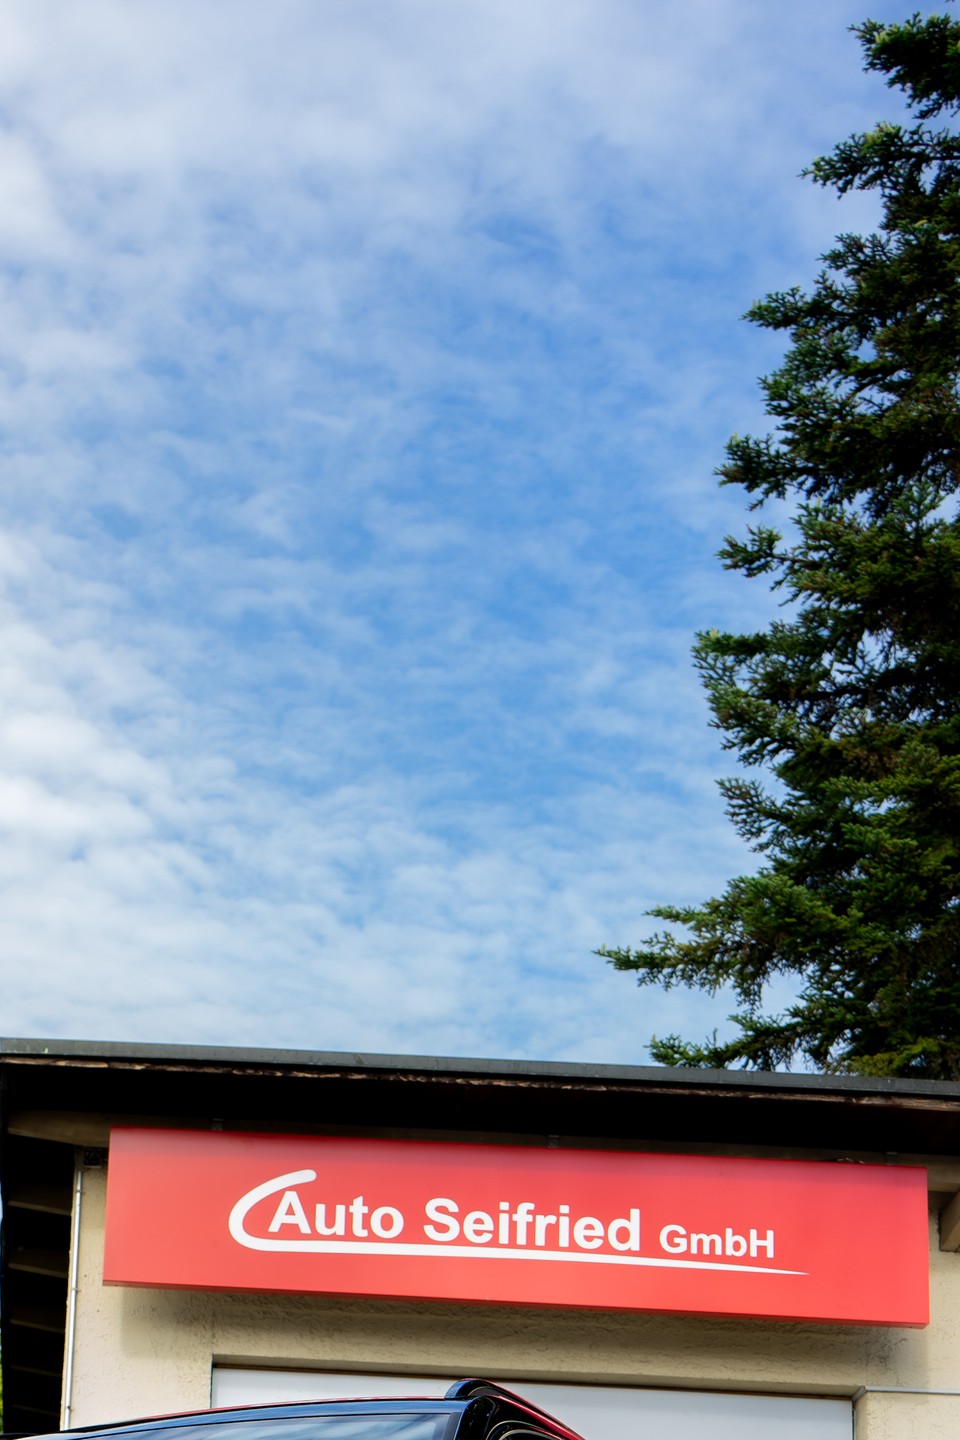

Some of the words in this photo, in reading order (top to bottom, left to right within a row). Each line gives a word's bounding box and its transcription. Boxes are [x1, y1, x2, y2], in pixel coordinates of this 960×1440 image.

[267, 1190, 406, 1240] Auto
[423, 1197, 641, 1251] Seifried
[659, 1224, 775, 1259] GmbH
